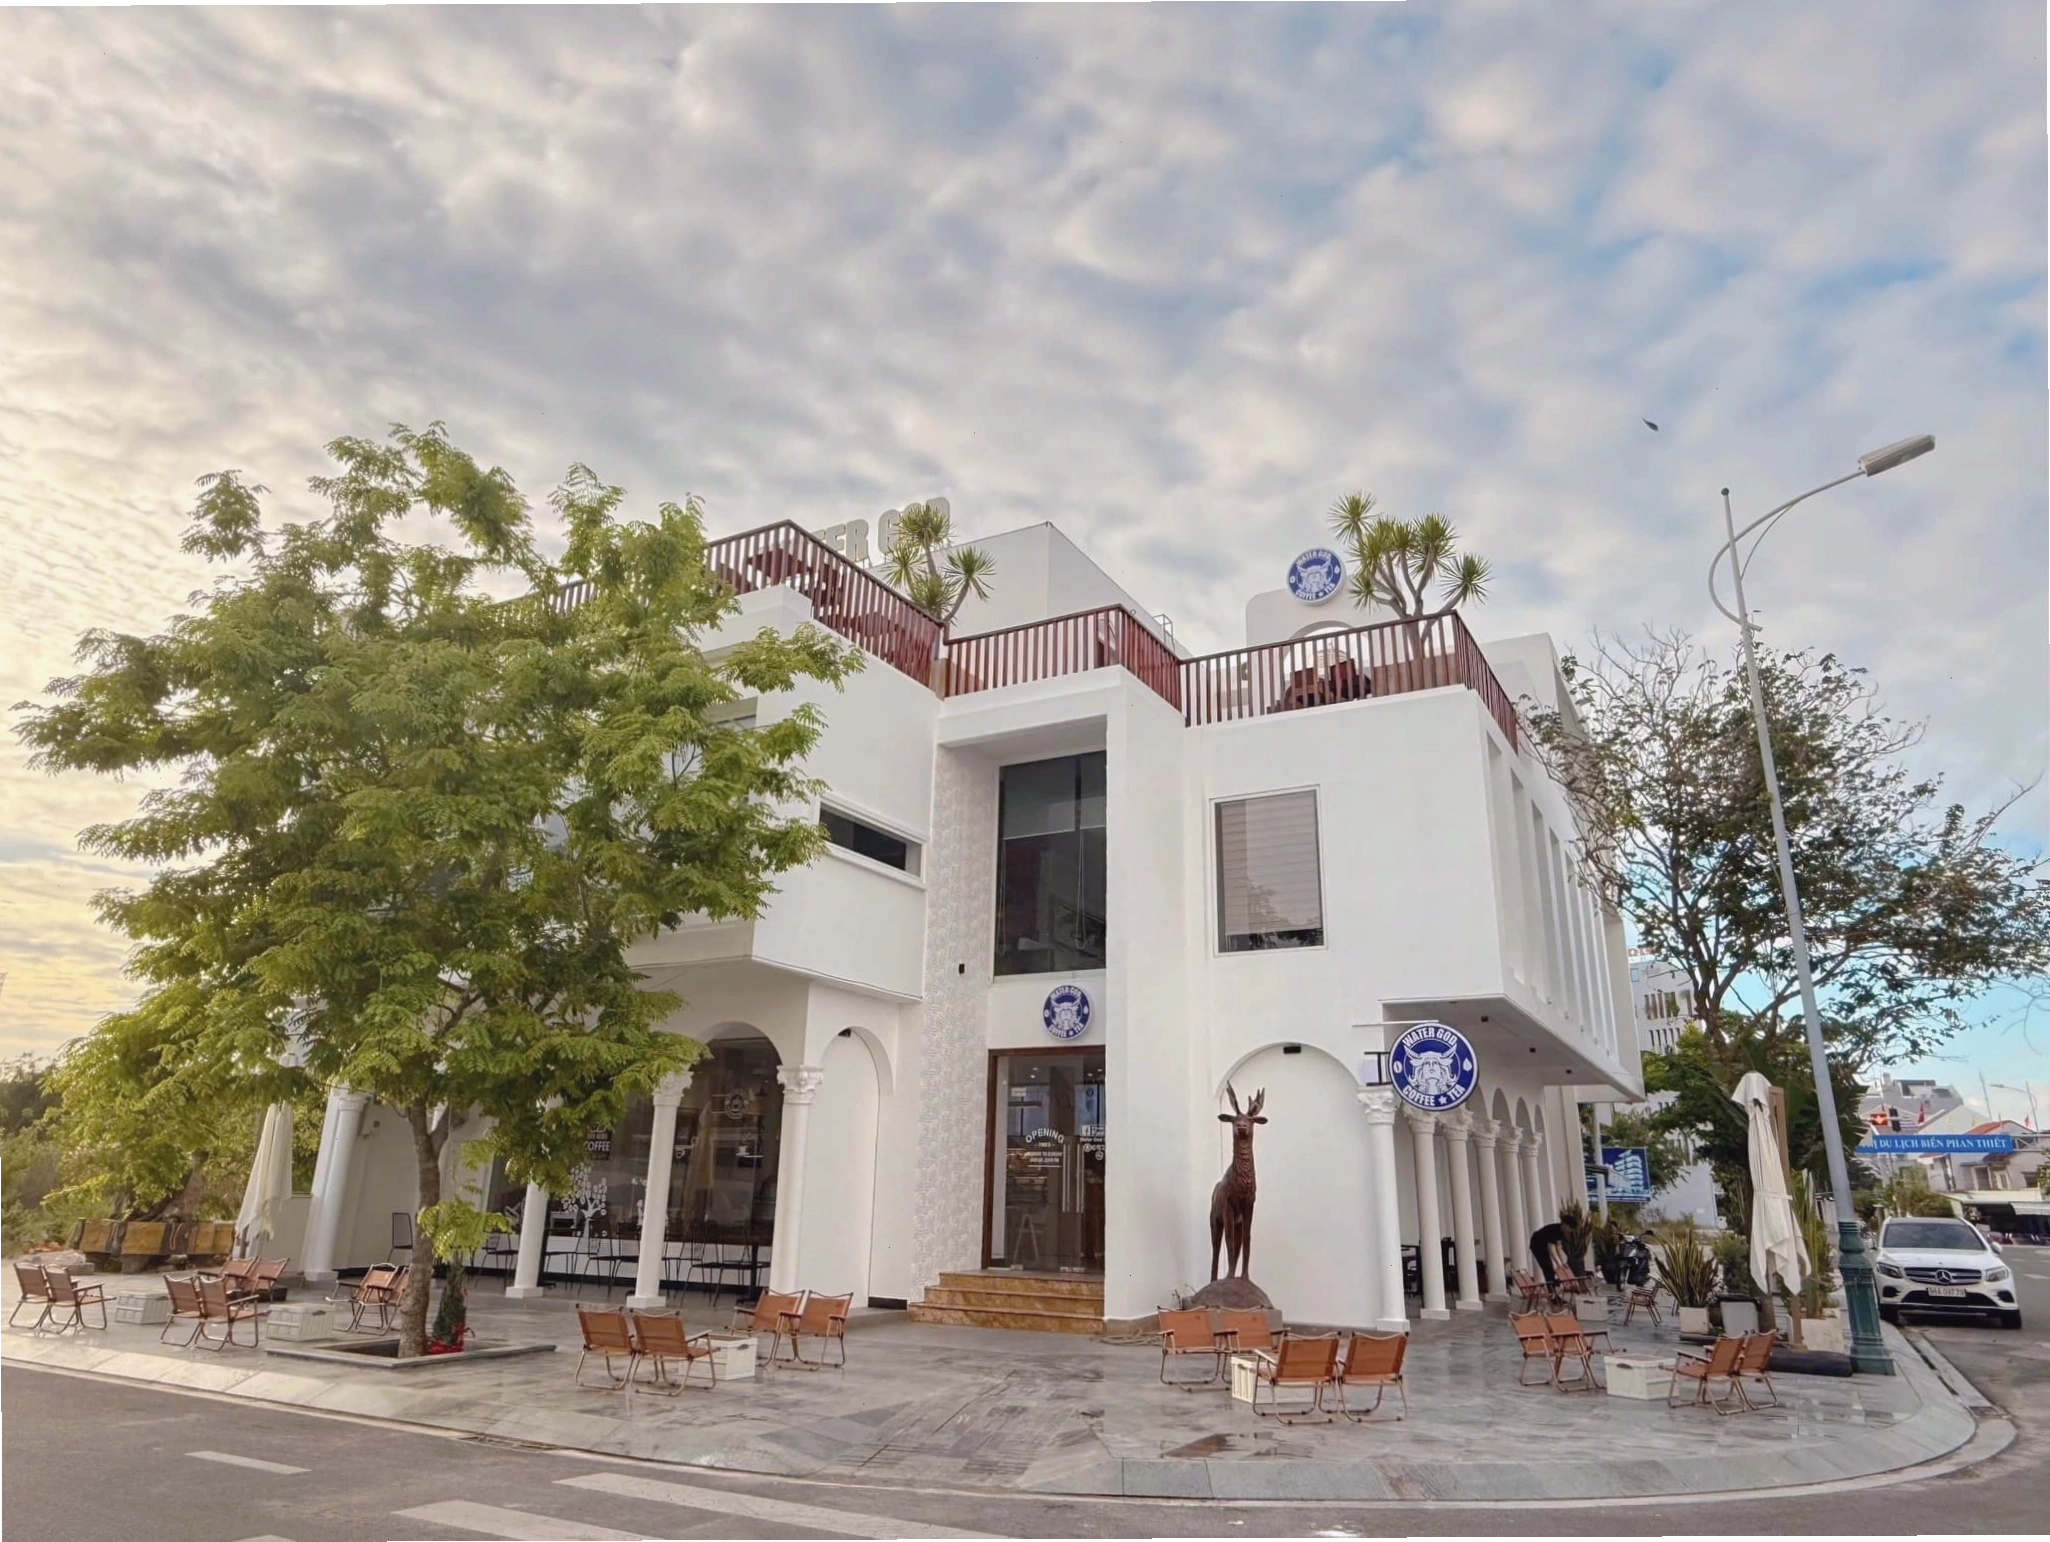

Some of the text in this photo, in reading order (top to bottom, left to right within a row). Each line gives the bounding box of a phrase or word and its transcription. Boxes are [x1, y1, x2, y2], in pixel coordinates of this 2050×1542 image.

[1402, 1027, 1458, 1047] WATER GOD
[1402, 1083, 1466, 1106] COFFEE TEA
[1025, 1127, 1065, 1144] OPENING
[1880, 1139, 1892, 1148] DU
[1895, 1139, 1919, 1150] LỊCH
[1946, 1138, 1972, 1148] PHAN
[1975, 1136, 2007, 1148] THIẾT
